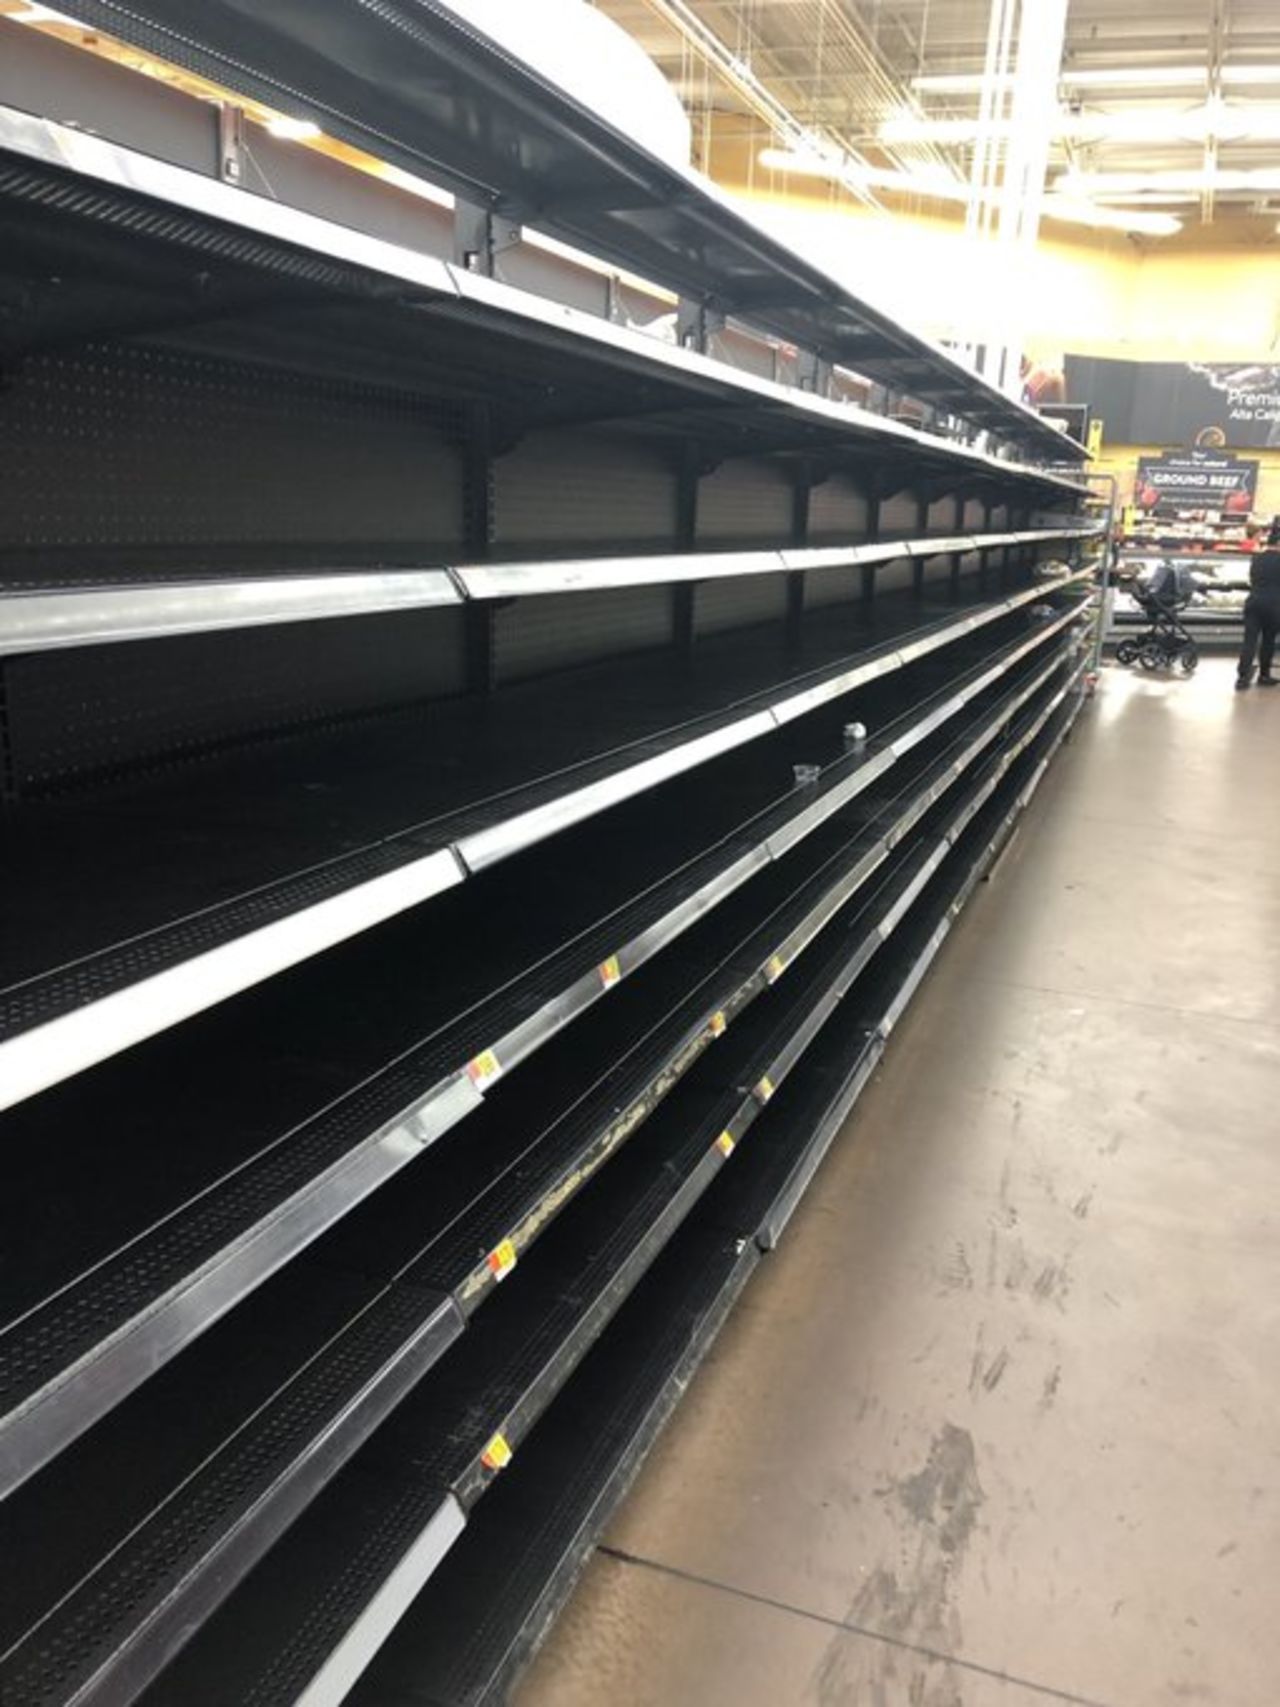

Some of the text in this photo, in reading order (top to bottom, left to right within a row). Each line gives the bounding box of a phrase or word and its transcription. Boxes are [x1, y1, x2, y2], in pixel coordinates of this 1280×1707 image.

[1229, 408, 1253, 420] Alta
[1153, 474, 1239, 487] GROUND BEEF
